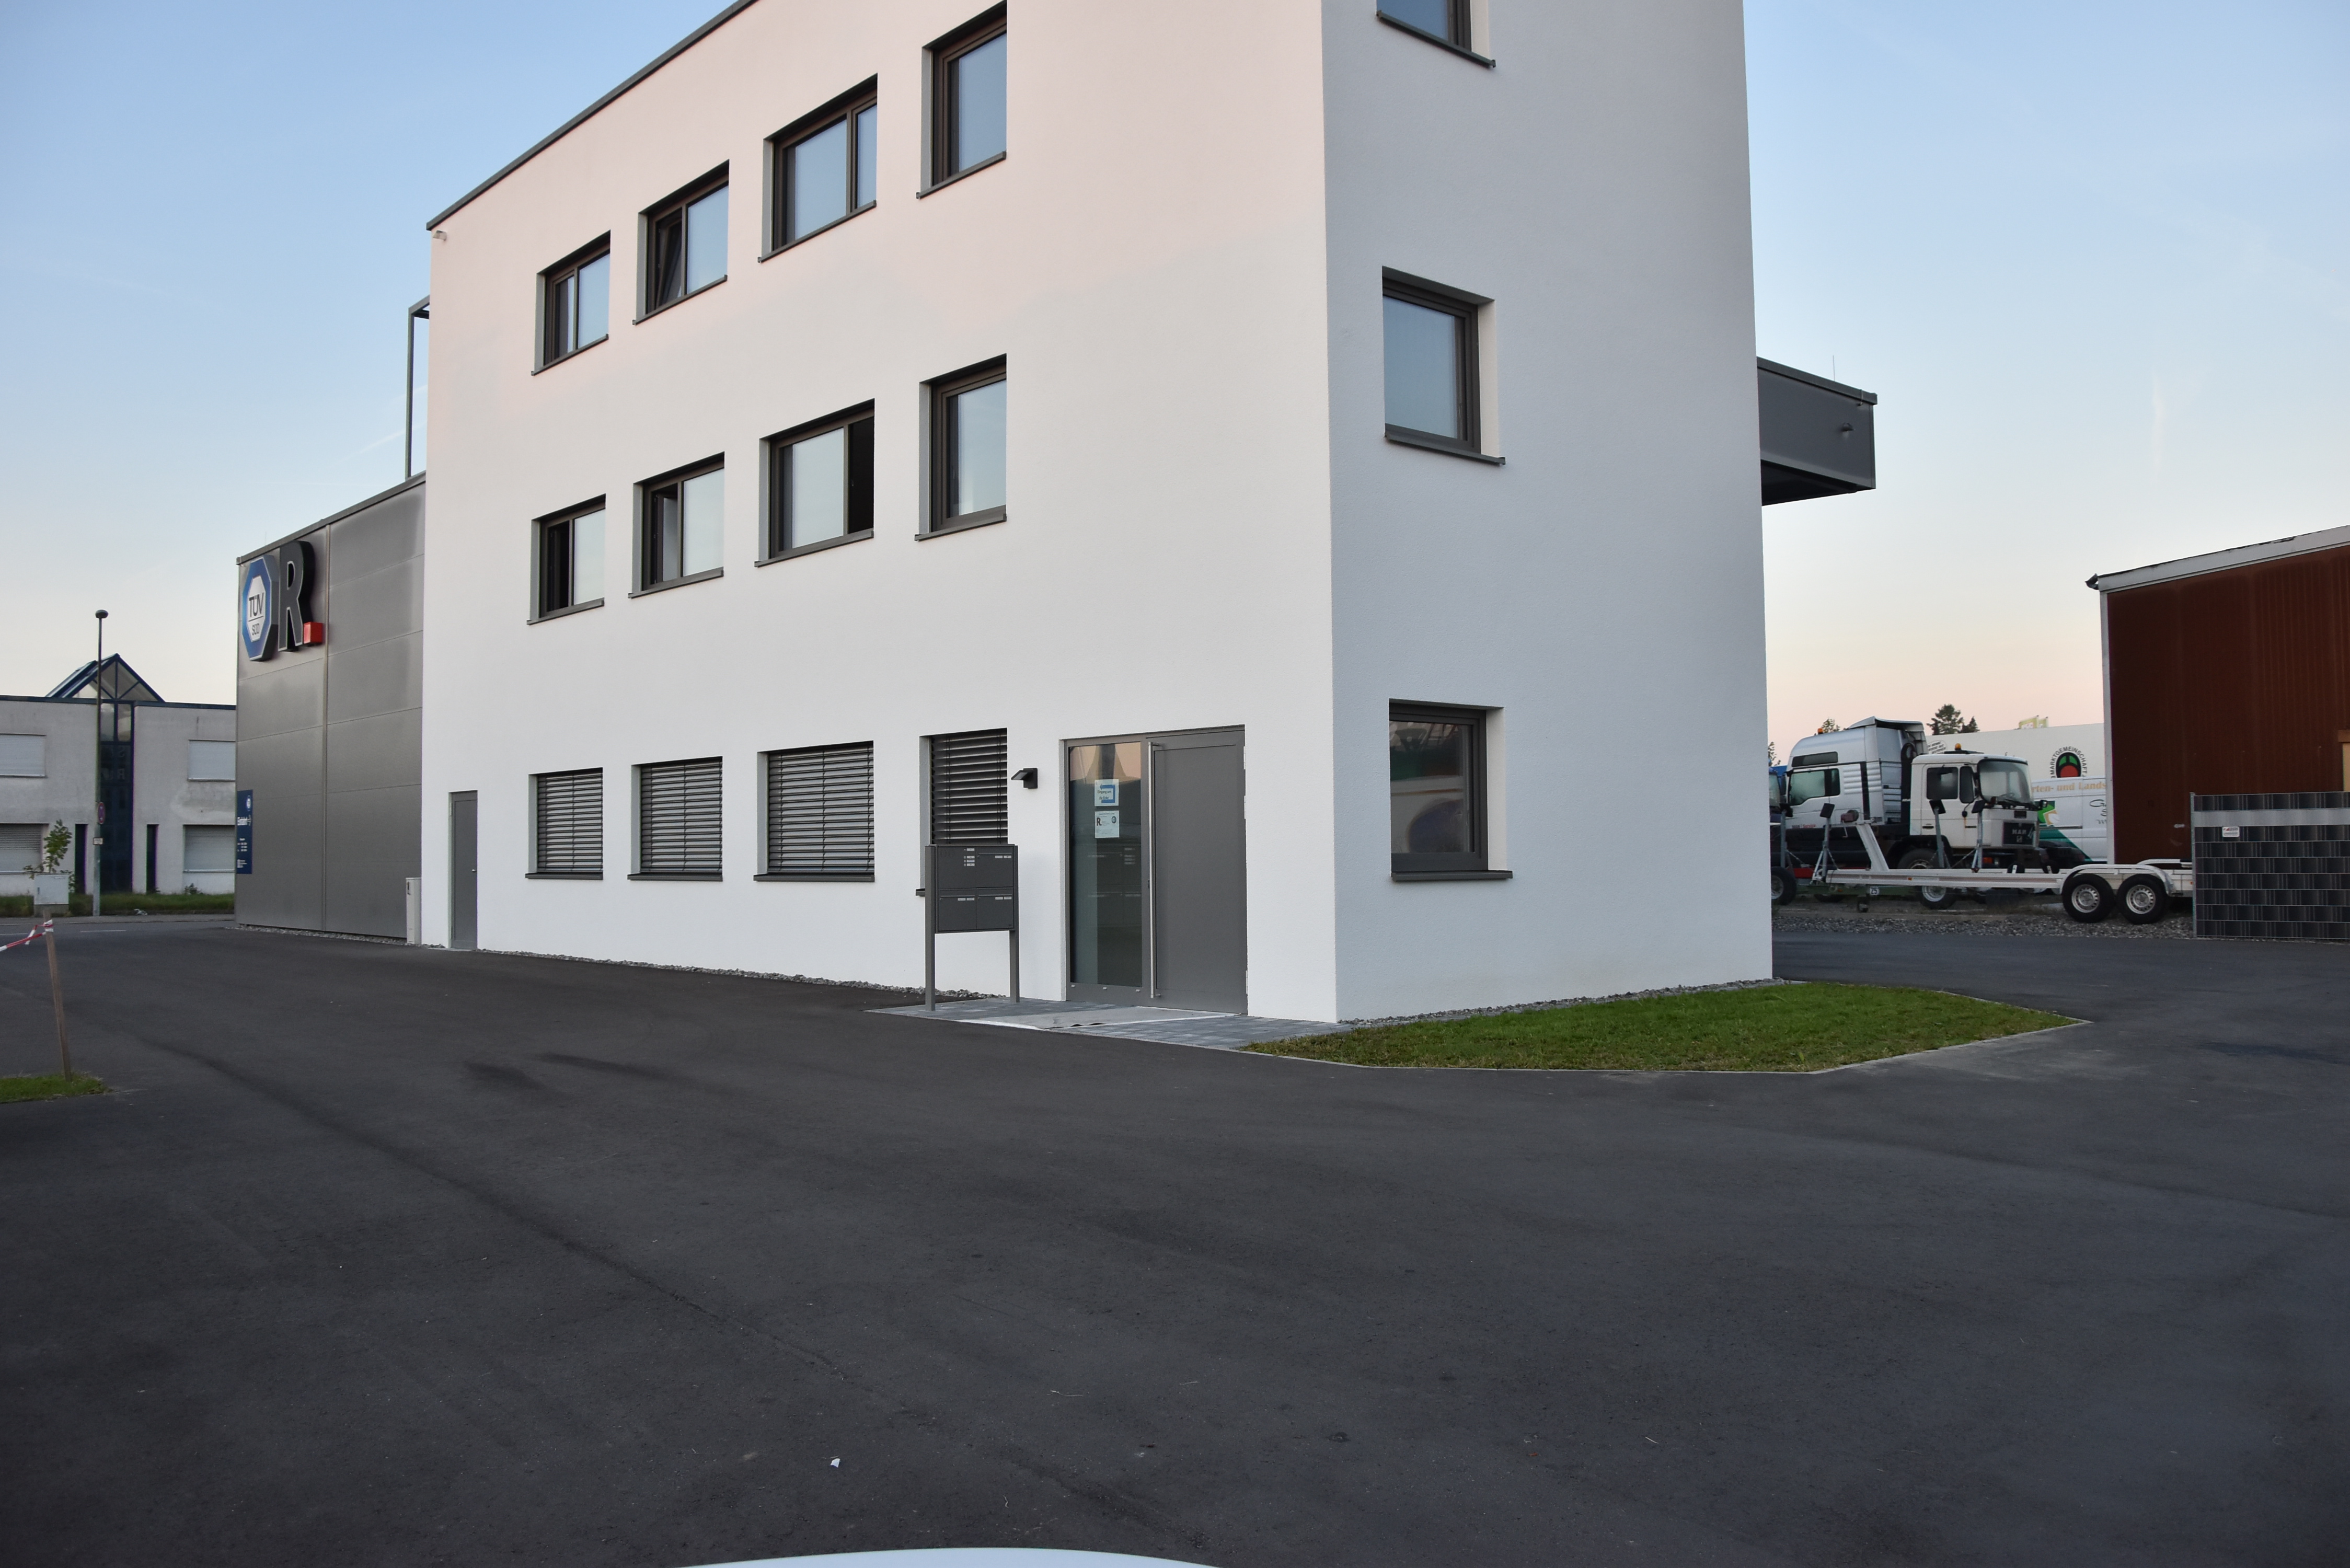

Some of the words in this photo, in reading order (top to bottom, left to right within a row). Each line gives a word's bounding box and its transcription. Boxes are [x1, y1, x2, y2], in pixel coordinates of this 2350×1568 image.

[248, 592, 264, 618] TÜV
[2057, 782, 2075, 791] und
[2079, 781, 2106, 790] Lands
